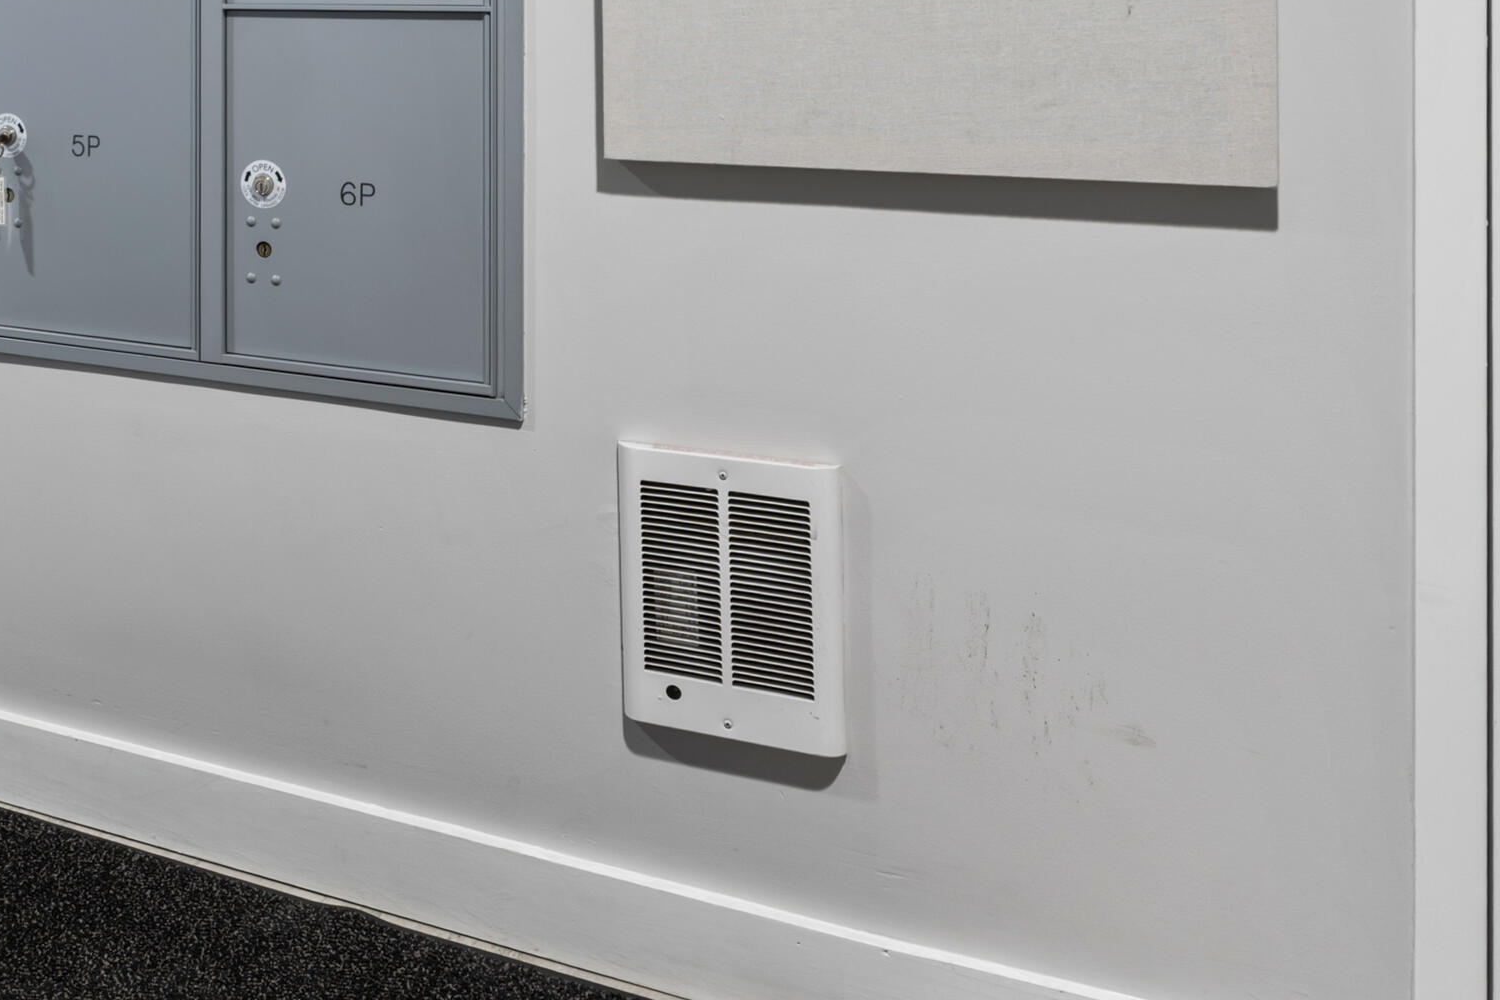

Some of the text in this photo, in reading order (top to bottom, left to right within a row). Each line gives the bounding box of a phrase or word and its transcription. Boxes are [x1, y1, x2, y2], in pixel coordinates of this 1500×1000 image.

[71, 134, 101, 158] 5P
[252, 163, 274, 172] OPEN
[340, 181, 376, 207] 6P
